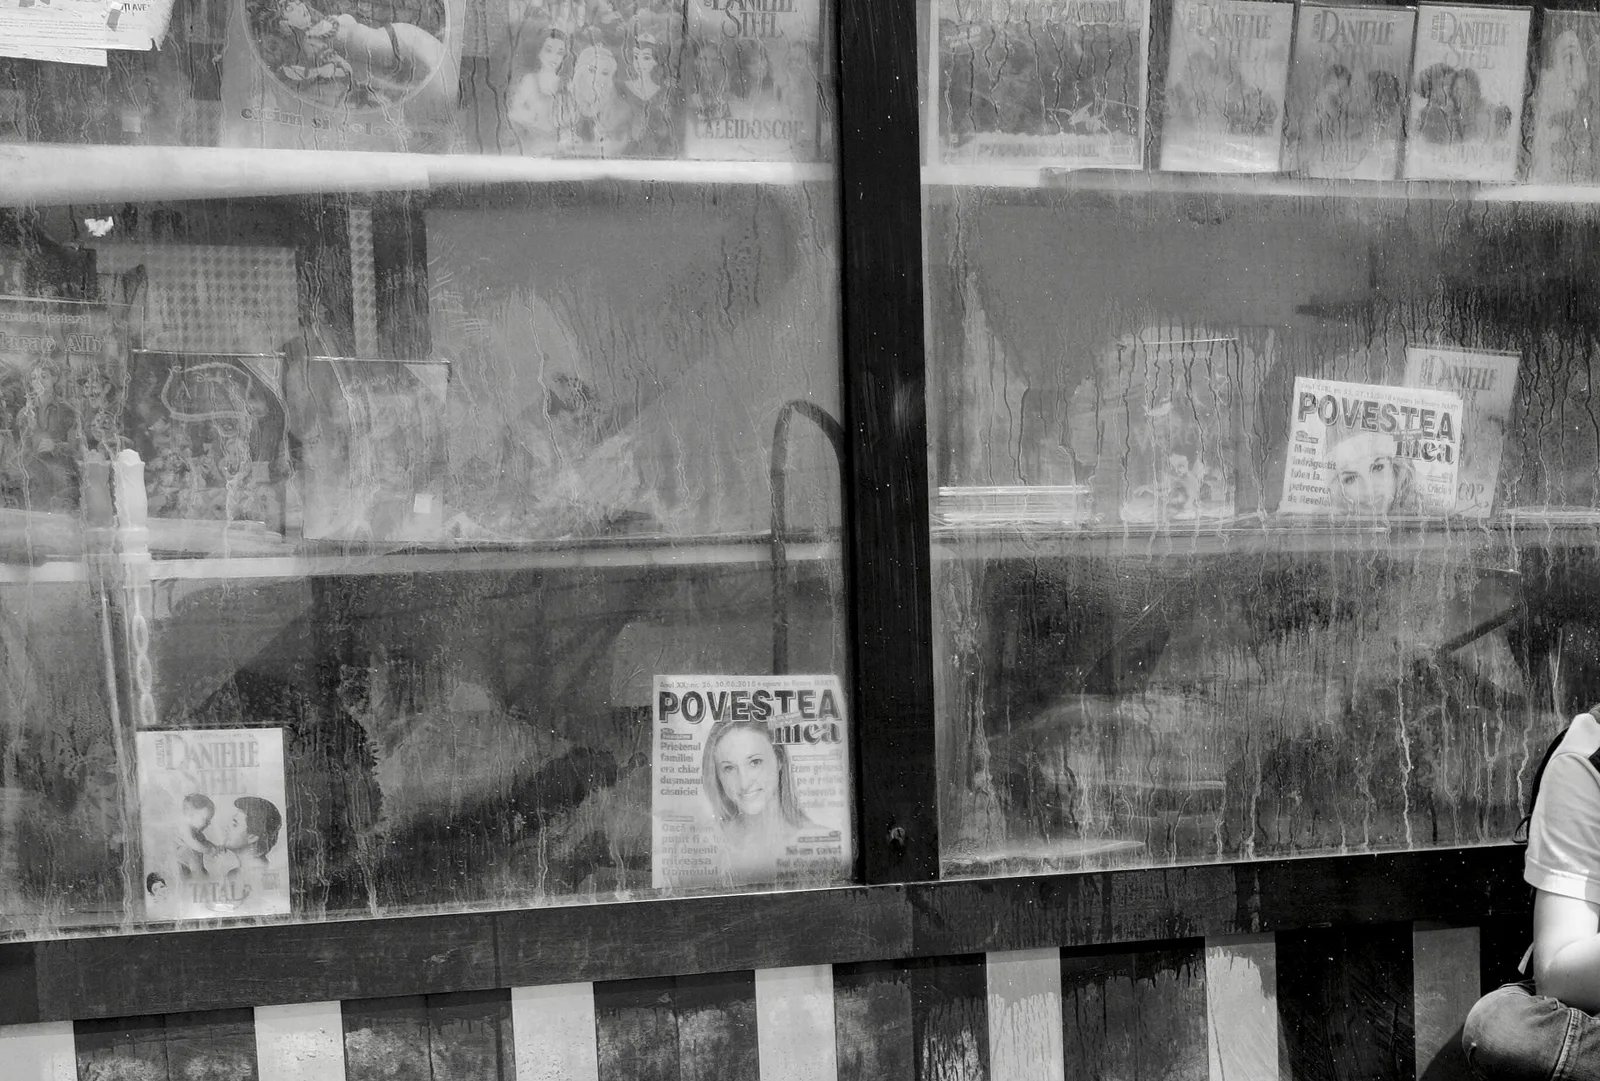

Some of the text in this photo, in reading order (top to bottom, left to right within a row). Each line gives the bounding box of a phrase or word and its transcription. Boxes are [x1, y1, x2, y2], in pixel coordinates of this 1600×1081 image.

[721, 10, 784, 39] STEEL
[1318, 10, 1396, 46] DANIELLE
[1438, 11, 1512, 46] DANIELLE
[1298, 391, 1455, 443] POVESTEA
[1395, 440, 1454, 465] mea
[659, 690, 843, 724] POVESTEA
[661, 742, 701, 751] Prietenul
[772, 722, 843, 746] mea
[164, 734, 260, 771] DANIELLE
[660, 753, 694, 762] familiei
[660, 776, 704, 787] dușmanul
[678, 764, 700, 774] chiar
